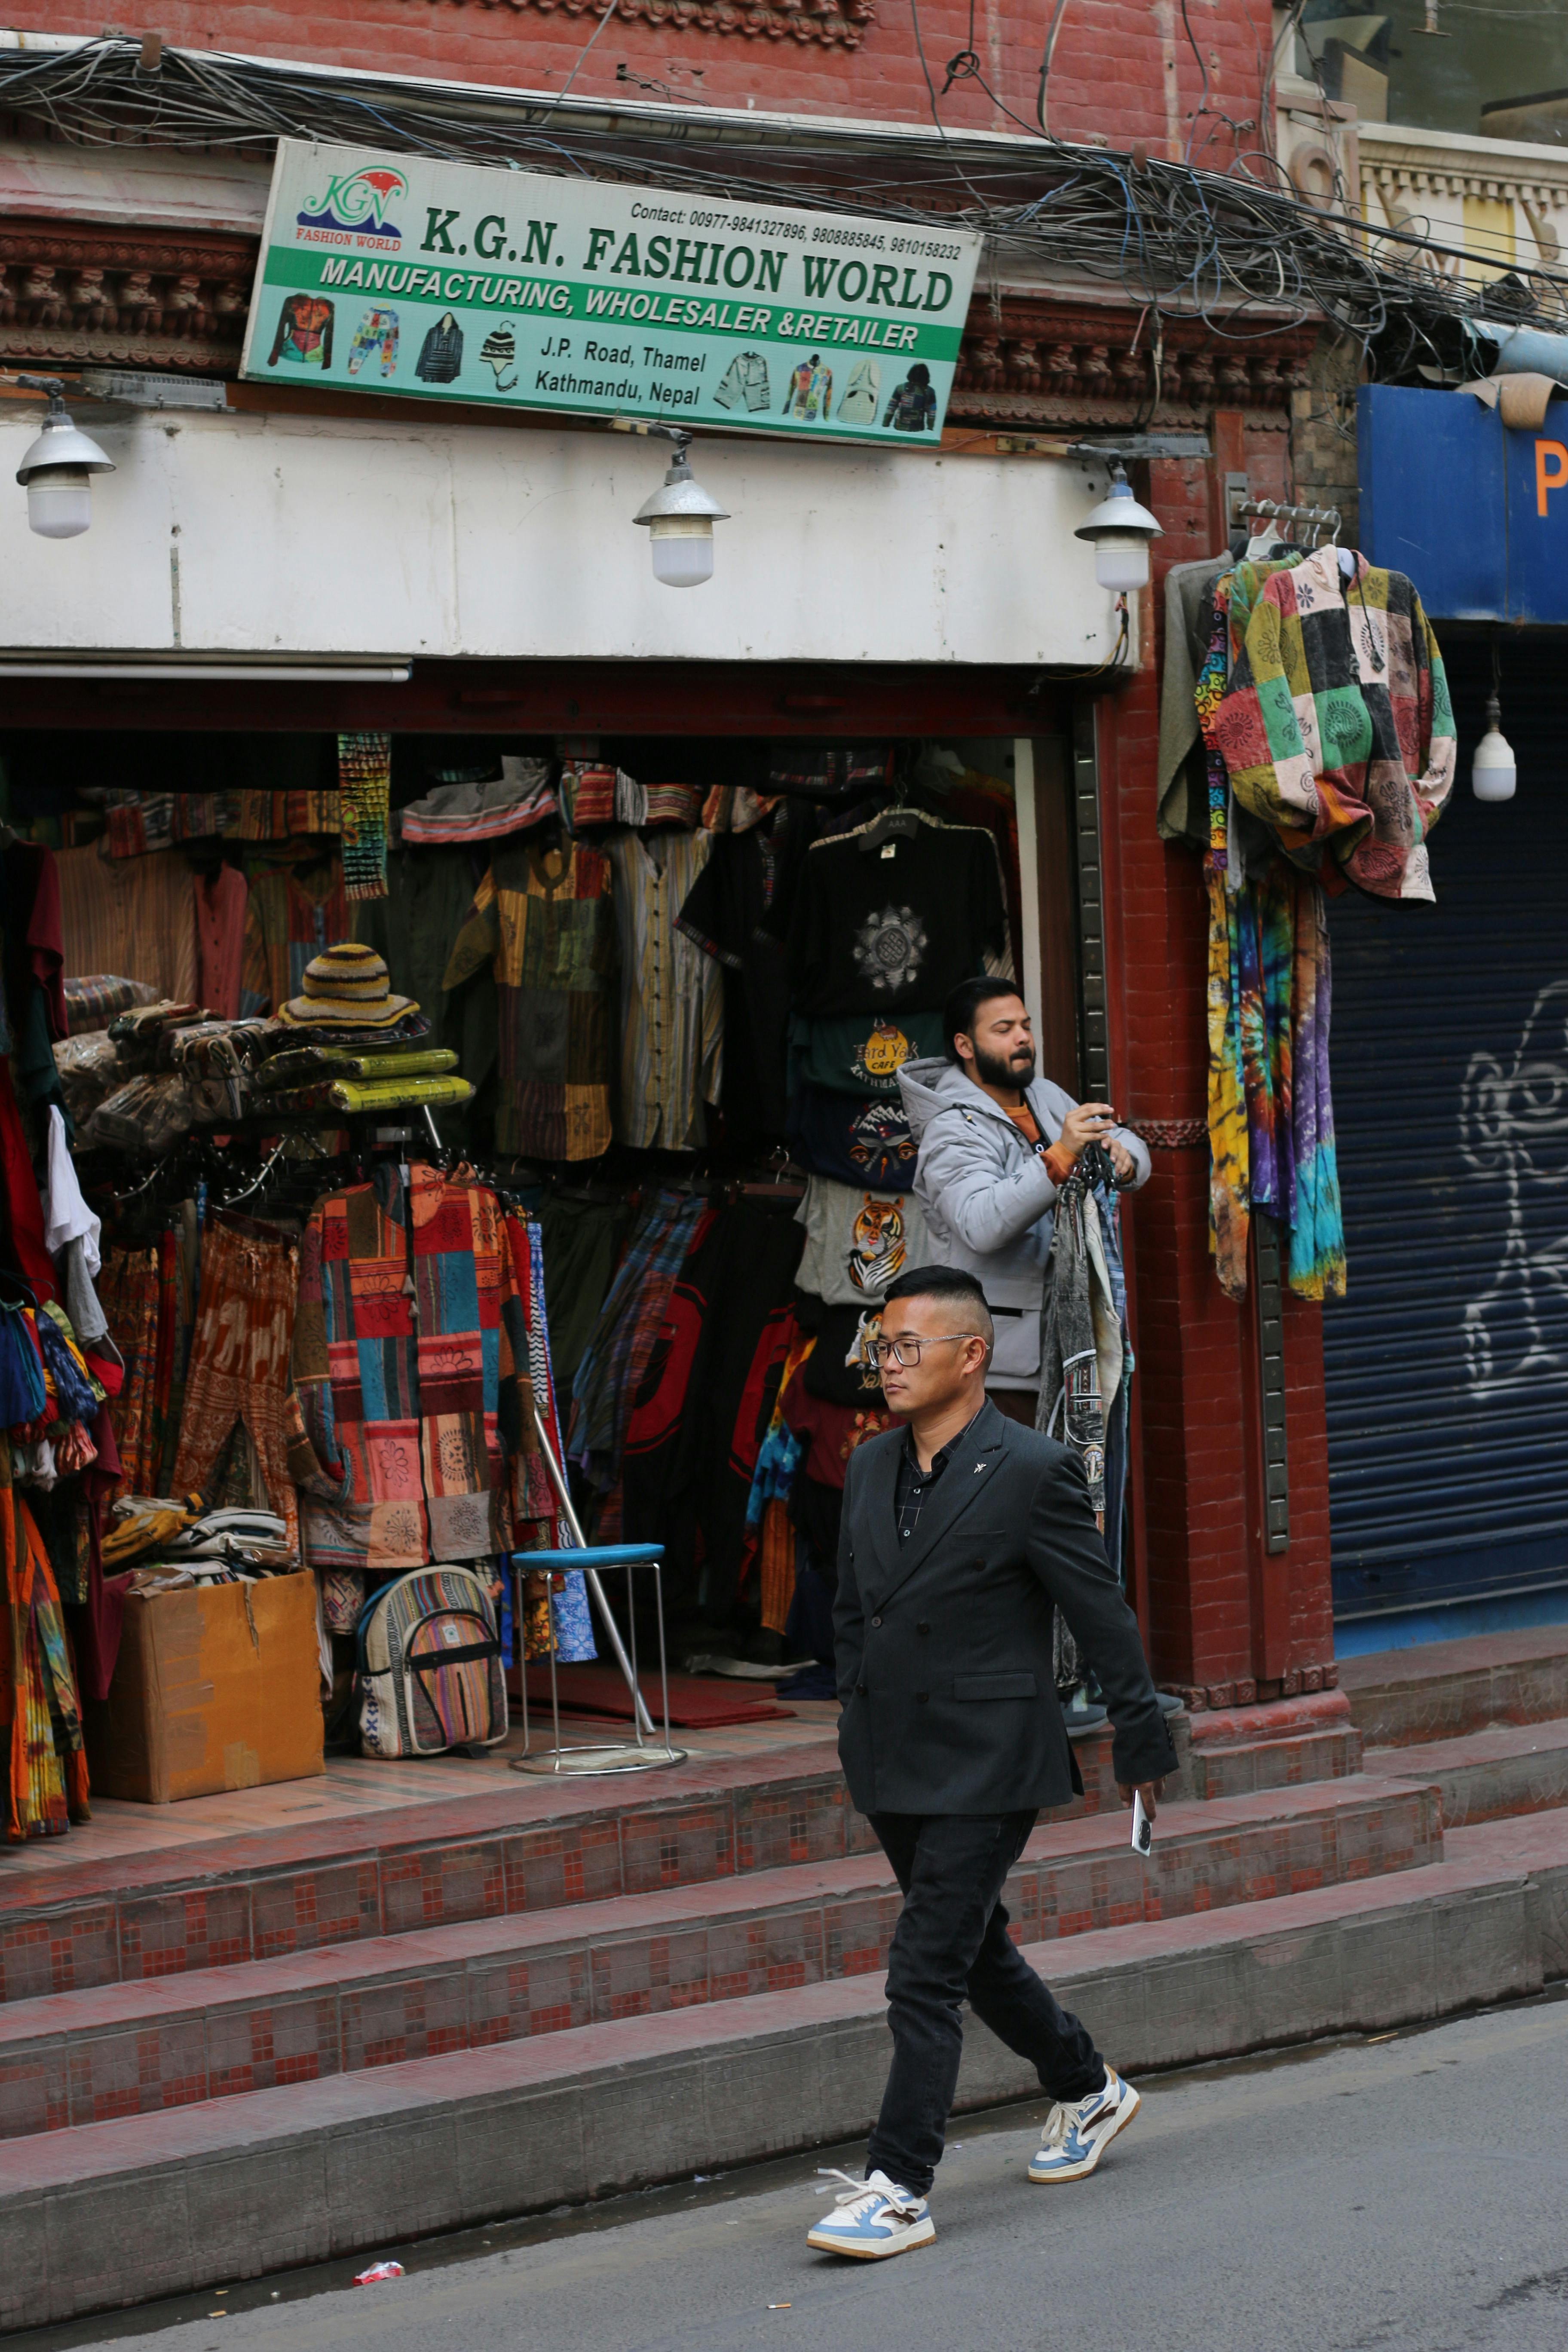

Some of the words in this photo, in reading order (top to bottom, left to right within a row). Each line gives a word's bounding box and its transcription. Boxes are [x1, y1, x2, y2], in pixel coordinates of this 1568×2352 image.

[303, 165, 408, 223] KGN
[296, 228, 352, 245] FASHION
[356, 236, 401, 251] WORLD
[631, 203, 686, 224] Contact:
[689, 211, 806, 242] 00977-9841327896,
[890, 238, 961, 260] 9810158232
[420, 207, 564, 266] K.G.N.
[582, 228, 788, 292] FASHION
[802, 254, 953, 312] WORLD
[319, 258, 574, 316] MANUFACTURING,
[585, 289, 772, 333] WHOLESALER
[778, 310, 919, 351] &RETAILER
[541, 337, 572, 358] J.P.
[584, 341, 634, 368] Road,
[643, 347, 706, 372] Thamel
[536, 370, 642, 403] Kathmandu,
[649, 382, 700, 408] Nepal
[1535, 439, 1568, 516] P
[854, 1044, 886, 1061] Hard
[872, 1061, 895, 1069] CAFE
